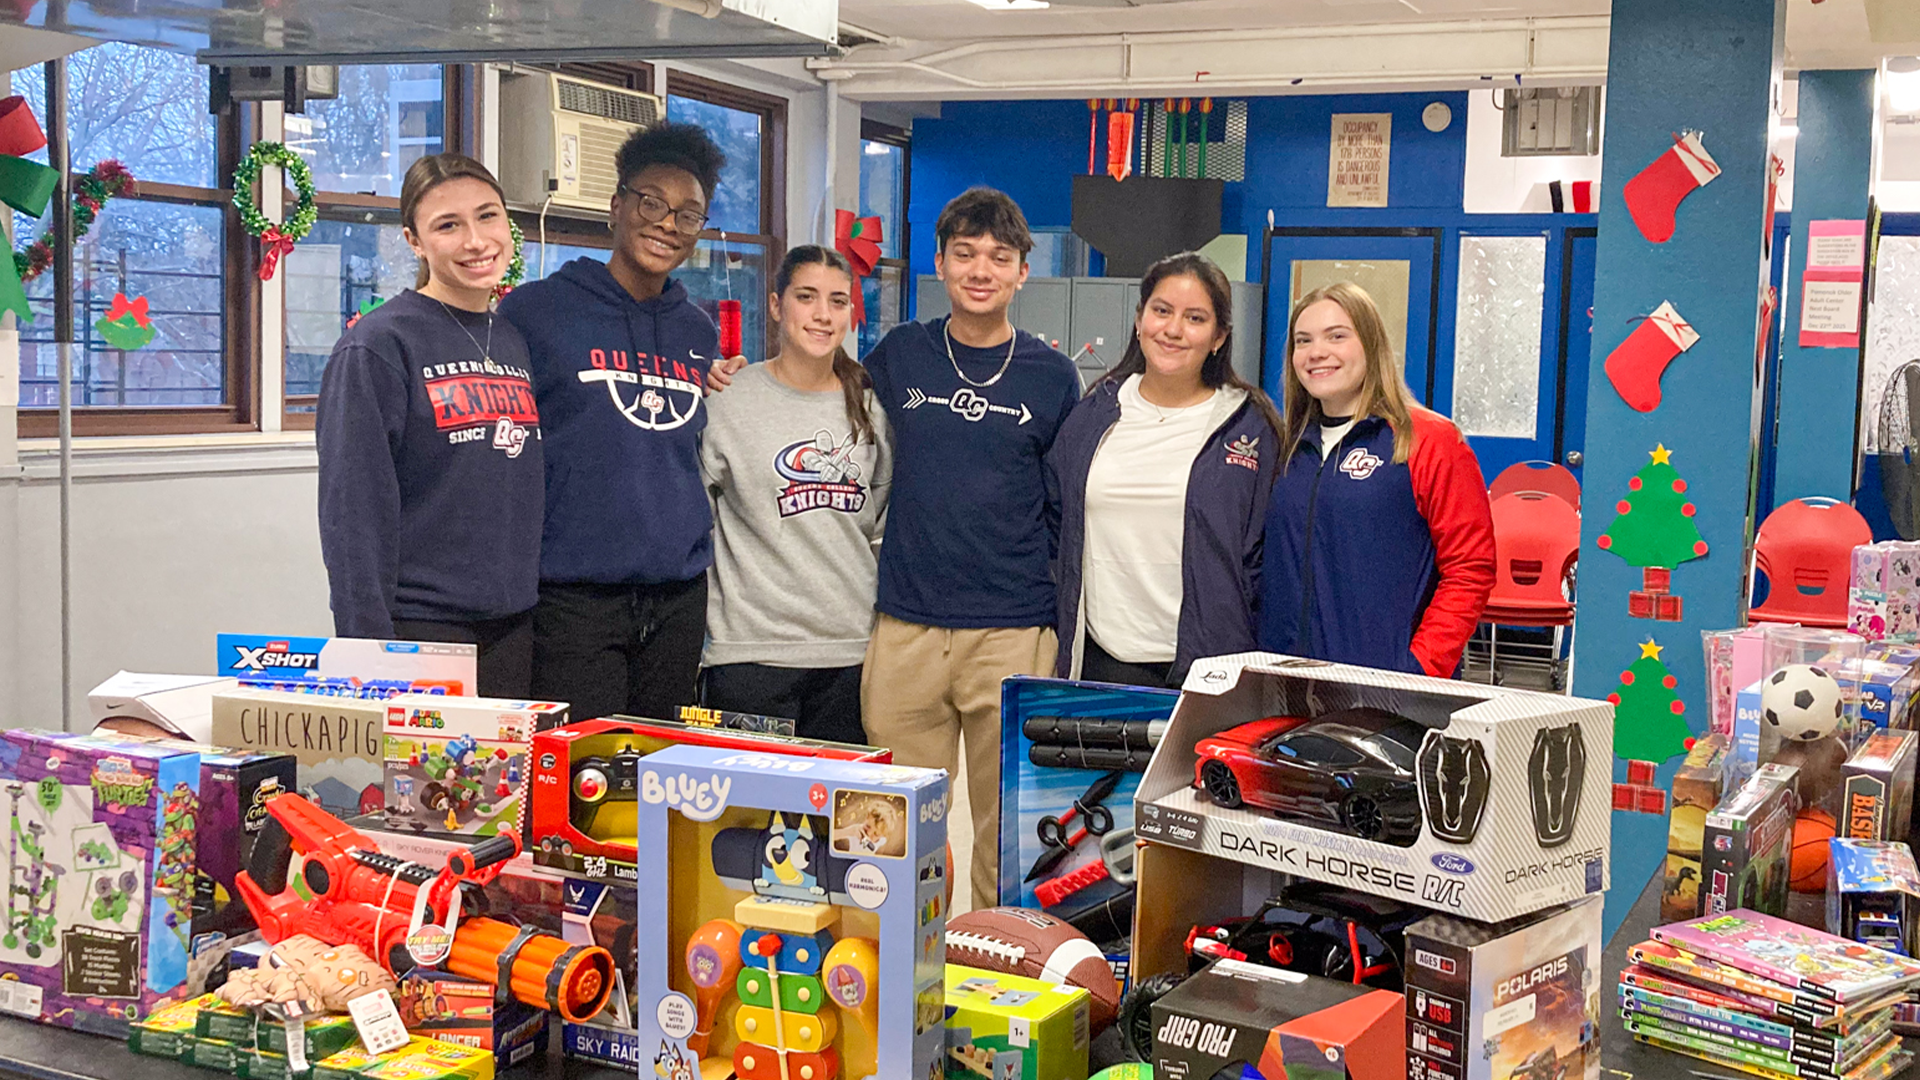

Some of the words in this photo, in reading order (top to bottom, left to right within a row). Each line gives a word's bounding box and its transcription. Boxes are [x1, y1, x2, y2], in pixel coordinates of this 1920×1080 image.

[1343, 121, 1378, 133] OCCUPANCY
[1348, 135, 1363, 146] MORE
[1367, 134, 1383, 146] THAN
[1355, 148, 1383, 158] PERSONS
[1337, 161, 1344, 172] IS
[1346, 161, 1380, 172] DANGEROUS
[1336, 174, 1348, 185] AND
[590, 348, 702, 387] QUEENS
[988, 404, 1021, 417] COUNTRY
[779, 490, 863, 516] KNIGHTS
[413, 708, 441, 719] SUPER
[1866, 699, 1886, 713] VR
[389, 713, 405, 721] LEGO
[680, 706, 723, 724] JUNGLE
[409, 717, 445, 729] MARIO
[241, 707, 377, 756] CHICKAPIG
[538, 774, 557, 785] R/C
[642, 770, 731, 821] BLUEY
[812, 790, 825, 800] 3+
[920, 792, 948, 823] BLUEY
[1140, 823, 1162, 835] USB
[1168, 824, 1197, 840] TURBO
[396, 843, 411, 851] SKY
[411, 844, 434, 854] ROVER
[1288, 828, 1312, 844] FORD
[1313, 834, 1354, 855] MUSTANG
[1220, 831, 1297, 865] DARK
[1306, 851, 1415, 893] HORSE
[1438, 853, 1467, 873] Ford
[1504, 861, 1548, 884] DARK
[1552, 847, 1604, 872] HORSE
[849, 883, 886, 893] HARMONICA!
[860, 877, 874, 885] REAL
[1422, 874, 1465, 907] R/C
[408, 935, 428, 946] TRY
[1419, 952, 1438, 967] AGES
[1497, 956, 1568, 1000] POLARIS
[1800, 980, 1816, 990] DARK
[1816, 985, 1834, 997] HORSE
[666, 1008, 685, 1017] SONGS
[1796, 997, 1812, 1007] DARK
[1813, 1002, 1832, 1013] HORSE
[1428, 1003, 1452, 1023] USB
[1778, 1006, 1792, 1015] DARK
[1793, 1011, 1810, 1021] HORSE
[665, 1022, 686, 1031] BLUEY!
[1013, 1027, 1024, 1037] 1+
[1157, 1014, 1201, 1049] GRIP
[1428, 1028, 1438, 1038] ALL
[577, 1036, 604, 1054] SKY
[1197, 1022, 1238, 1058] PRO
[1709, 1021, 1718, 1029] THE
[1795, 1044, 1811, 1052] DARK
[1812, 1048, 1832, 1058] HORSE
[1794, 1032, 1810, 1040] DARK
[1812, 1036, 1832, 1045] HORSE
[1792, 1054, 1808, 1064] DARK
[1809, 1059, 1829, 1069] HORSE
[1800, 1068, 1816, 1077] DARK
